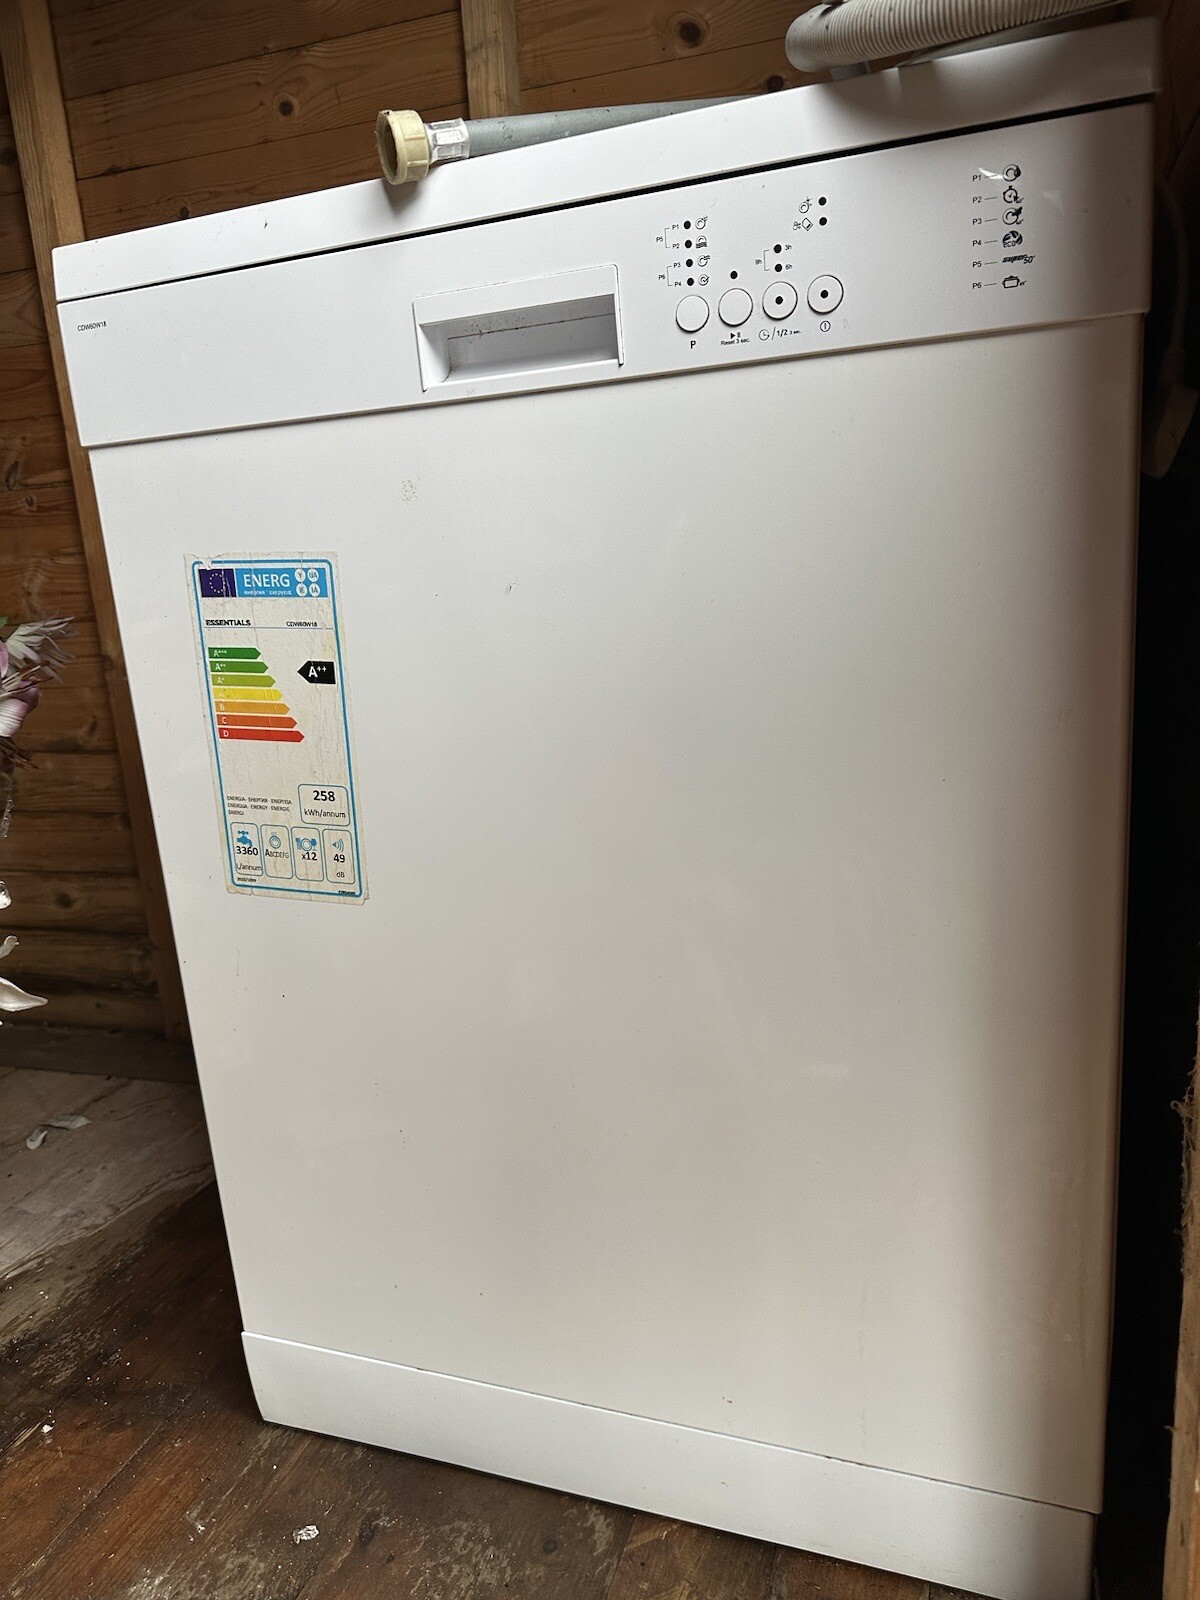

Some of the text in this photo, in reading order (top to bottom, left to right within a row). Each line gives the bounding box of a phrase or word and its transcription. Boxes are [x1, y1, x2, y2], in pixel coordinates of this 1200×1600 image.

[690, 340, 697, 349] P
[243, 574, 290, 588] ENERG
[308, 666, 327, 678] A++
[312, 790, 336, 802] 258
[304, 808, 346, 818] kWh/annum
[236, 846, 259, 856] 3360
[302, 852, 318, 861] x12
[333, 854, 346, 863] 49
